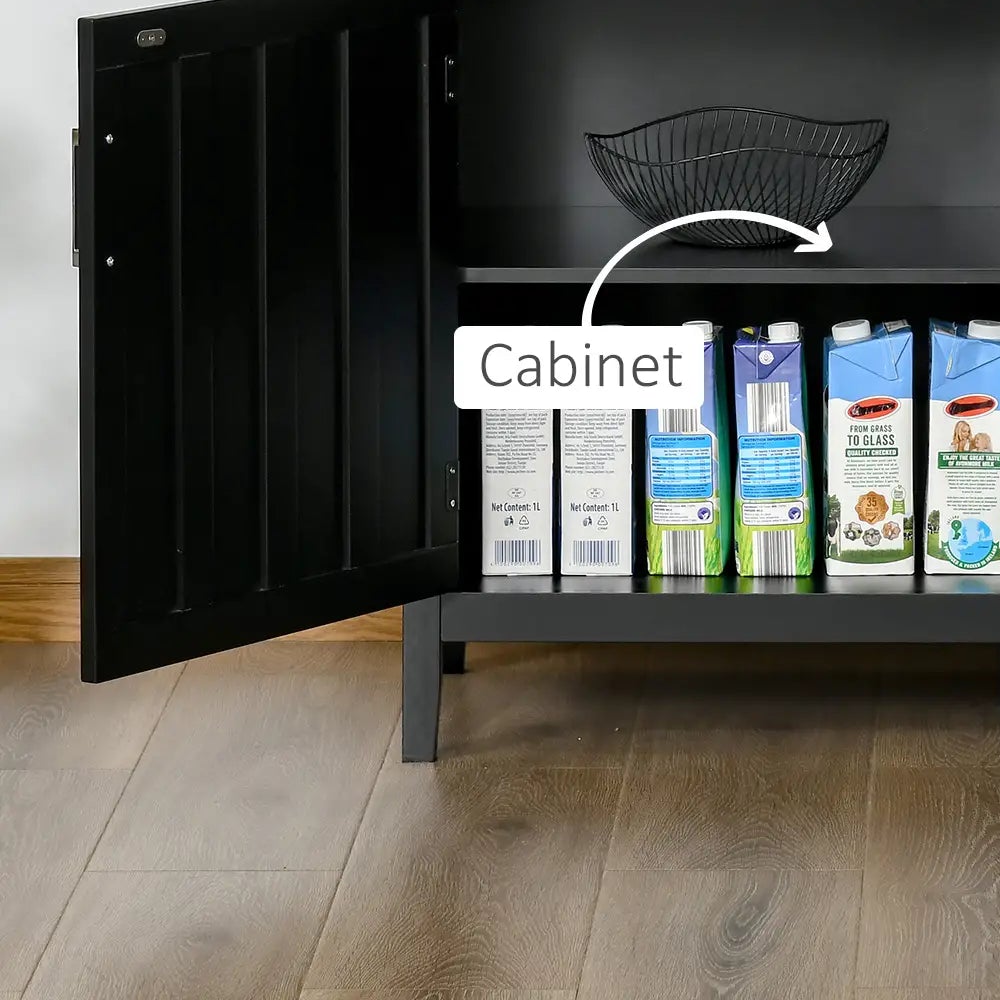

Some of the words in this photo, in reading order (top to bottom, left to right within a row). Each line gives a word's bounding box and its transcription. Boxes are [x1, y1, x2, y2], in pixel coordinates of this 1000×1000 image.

[850, 425, 868, 433] FROM
[870, 424, 892, 432] GRASS
[847, 434, 860, 446] TO
[863, 434, 895, 446] GLASS
[846, 449, 871, 457] QUALITY
[866, 496, 877, 507] 35
[491, 502, 503, 512] Net
[503, 502, 532, 512] Content:
[570, 502, 582, 512] Net
[582, 502, 610, 512] Content:
